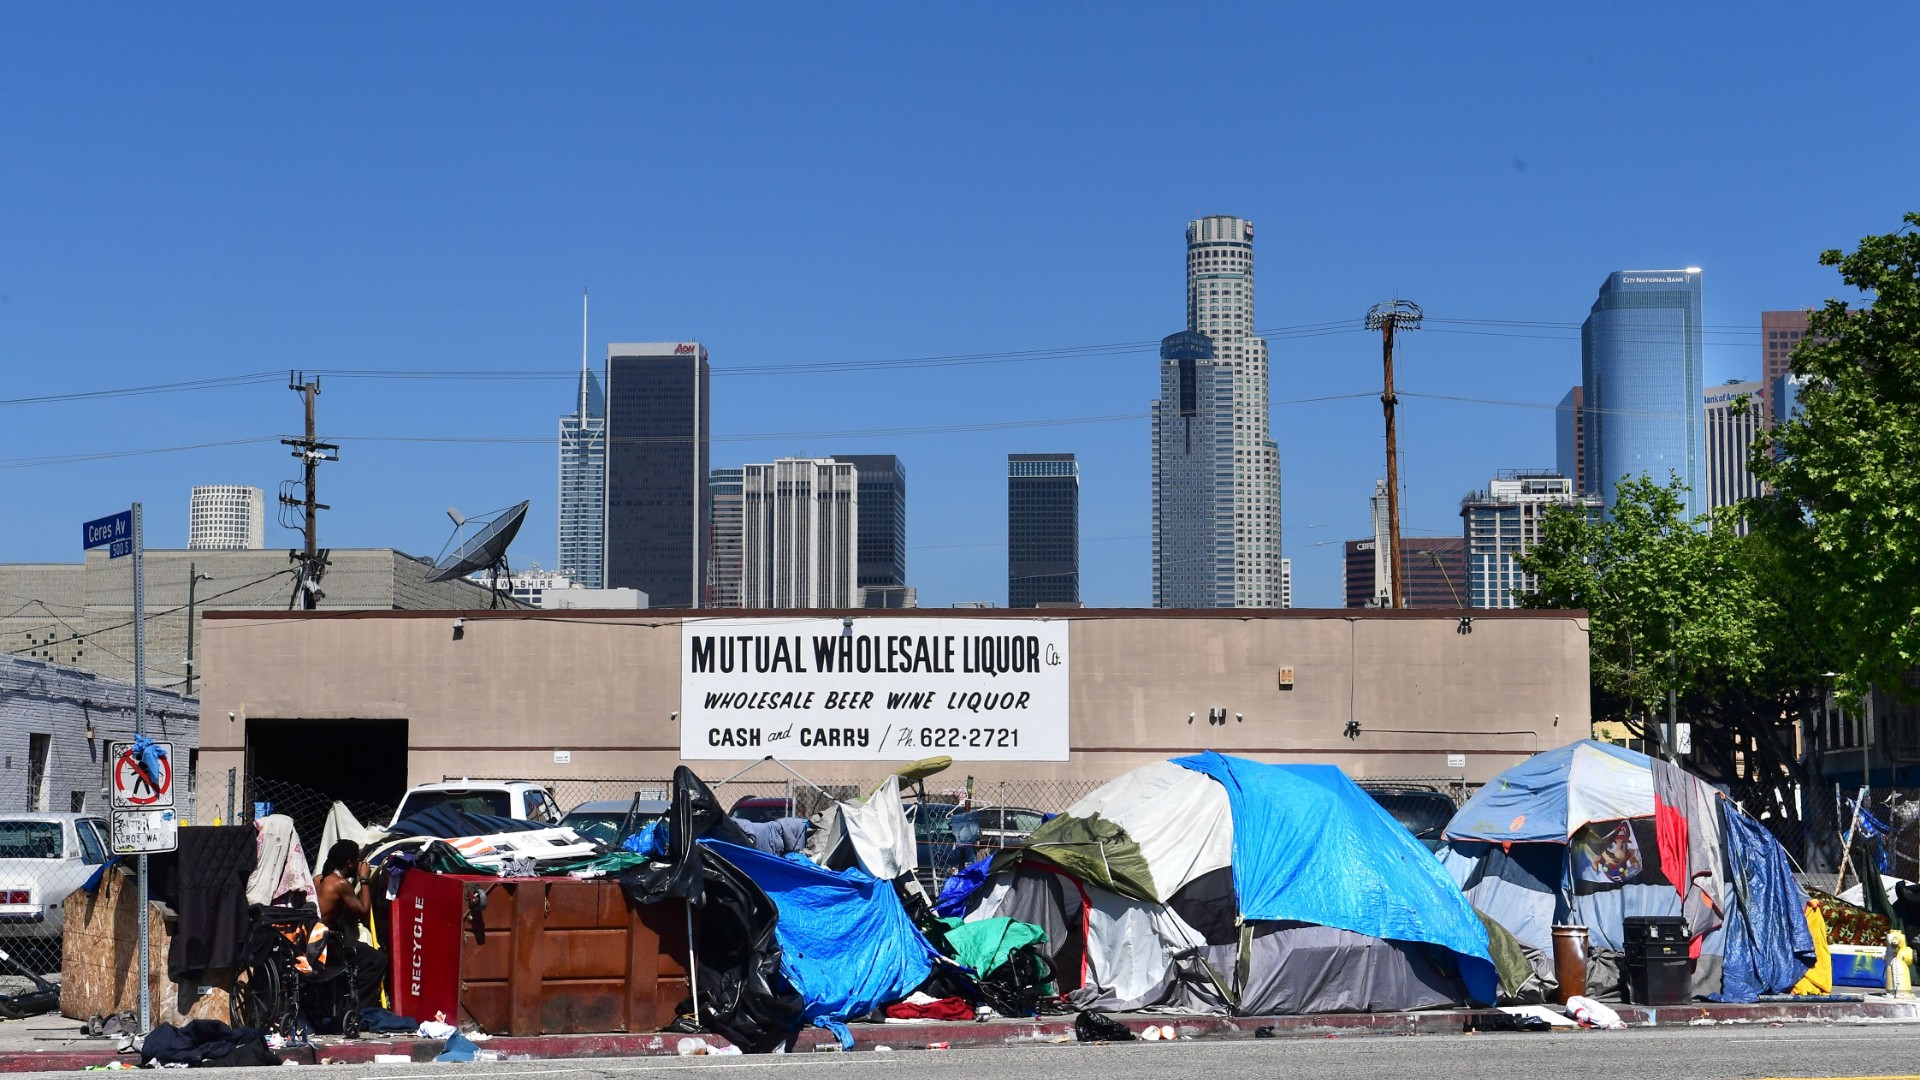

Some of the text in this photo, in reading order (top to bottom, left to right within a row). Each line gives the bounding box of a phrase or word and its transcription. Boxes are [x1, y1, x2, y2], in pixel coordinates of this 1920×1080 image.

[89, 518, 126, 543] Ceres Av
[113, 541, 129, 557] 500 S
[501, 580, 553, 588] WLSHIRE
[691, 634, 1062, 678] MUTUAL WHOLESALE LIQUOR Co.
[704, 690, 1031, 713] WHOLESALE BEER WINE LIQUOR
[708, 727, 761, 748] CASH
[767, 723, 793, 743] and
[800, 727, 870, 748] CARRY
[411, 896, 424, 997] RECYCLE
